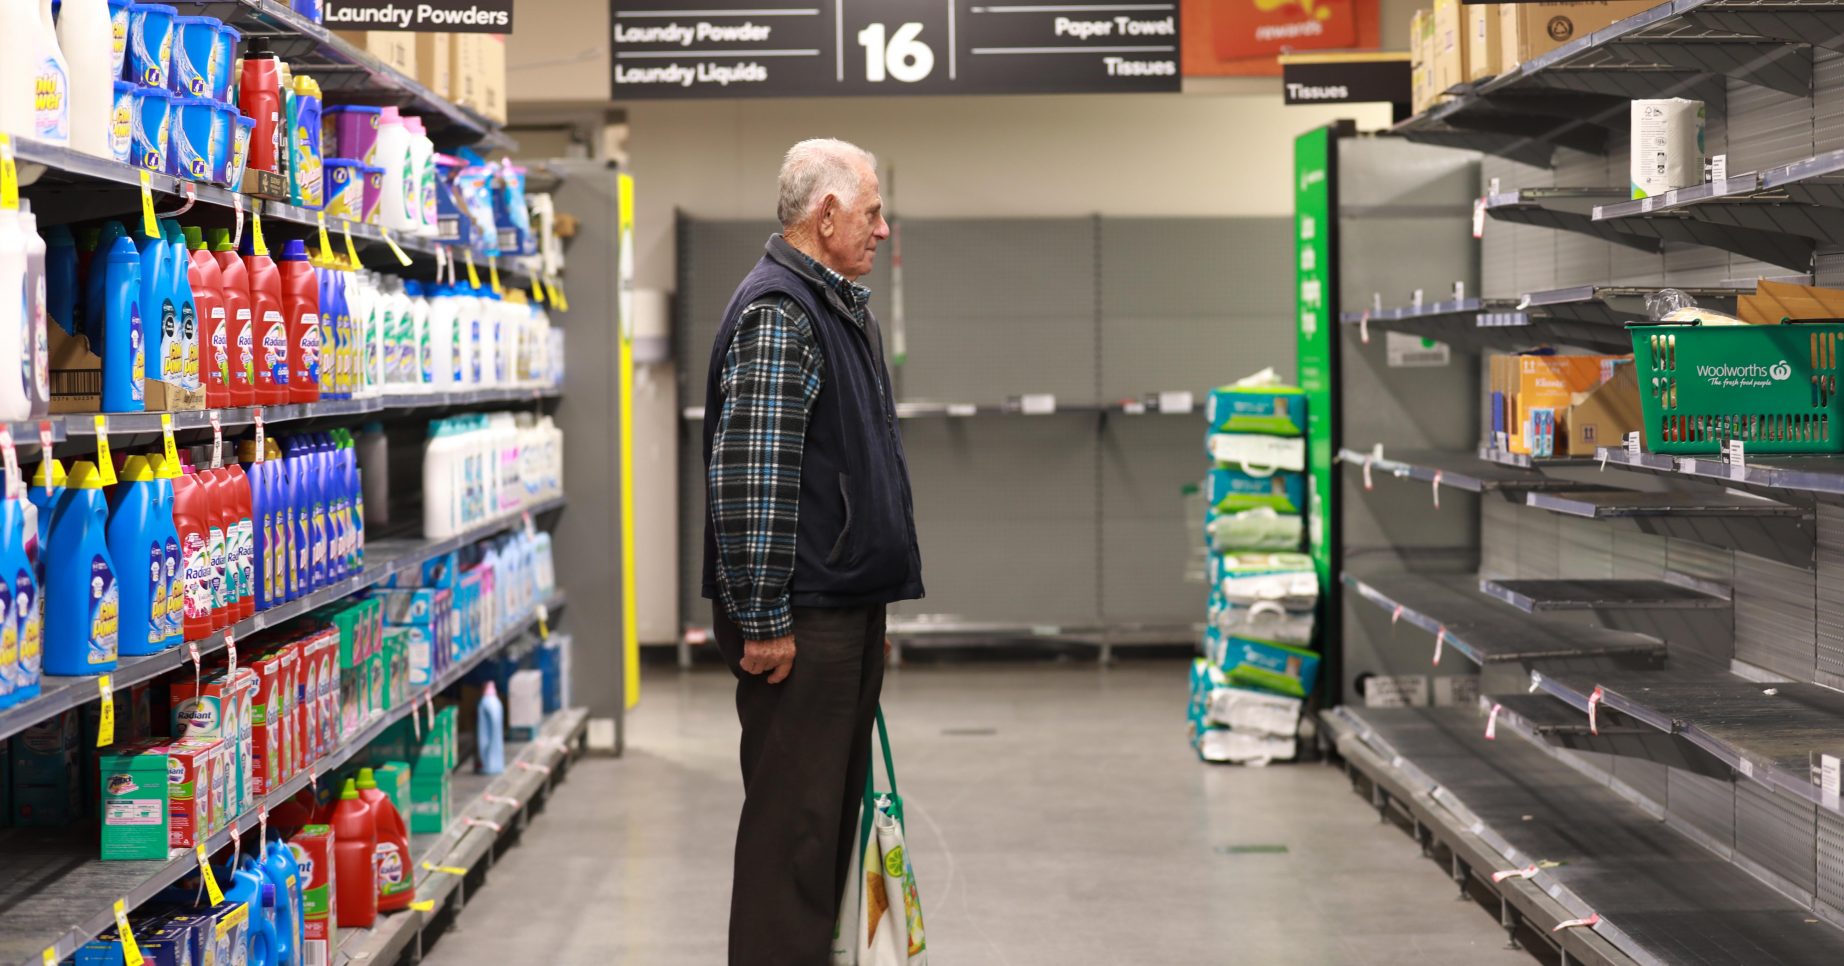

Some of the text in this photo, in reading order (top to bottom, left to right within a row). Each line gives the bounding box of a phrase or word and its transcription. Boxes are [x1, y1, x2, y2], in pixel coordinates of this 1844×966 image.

[325, 3, 509, 28] Laundry Powders
[614, 22, 771, 46] Laundry Powder
[1055, 16, 1175, 39] Paper Towel
[1256, 21, 1323, 41] rewards
[858, 22, 934, 82] 16
[615, 62, 768, 87] Laundry Liquids
[1103, 57, 1176, 76] Tissues
[1287, 83, 1348, 99] Tissues
[1696, 363, 1768, 377] Woolworths
[1707, 377, 1772, 388] The fresh food people
[178, 710, 212, 720] Radiant
